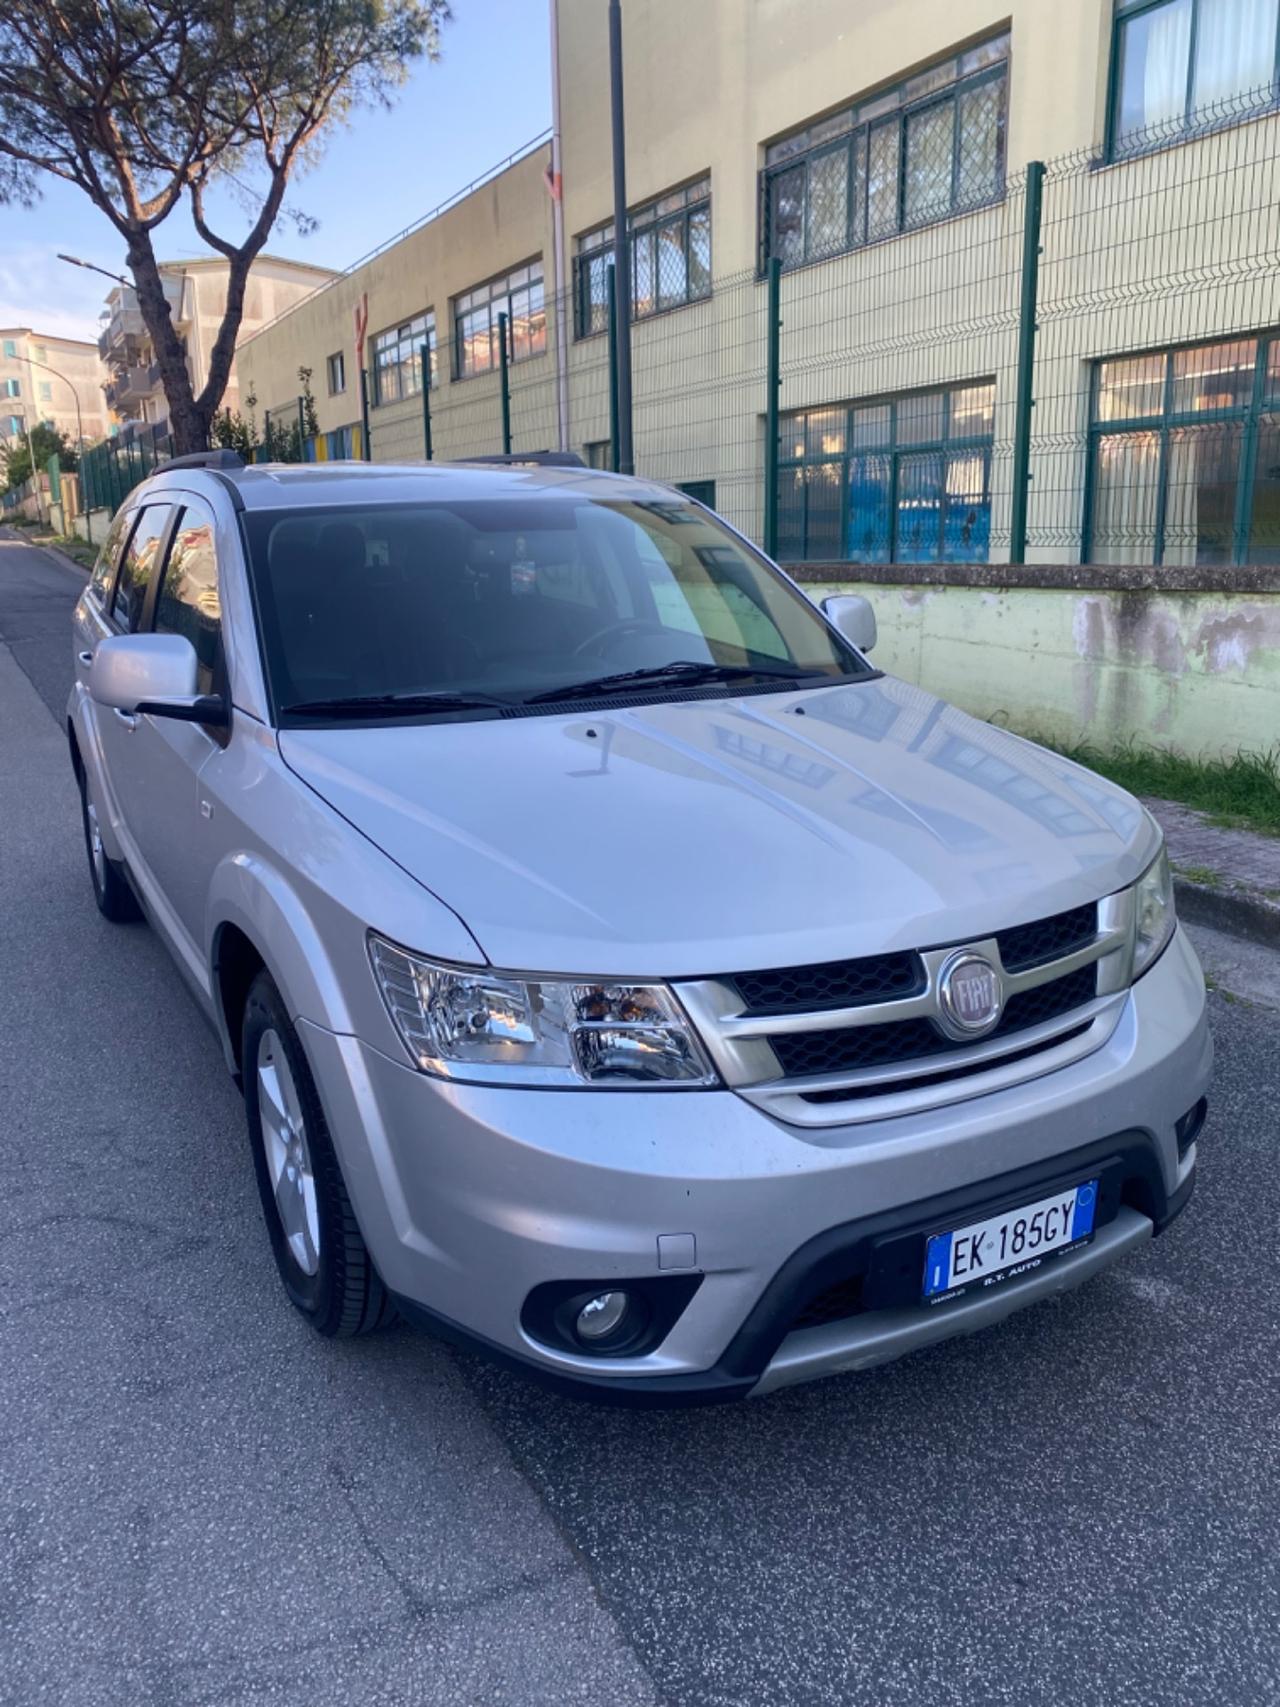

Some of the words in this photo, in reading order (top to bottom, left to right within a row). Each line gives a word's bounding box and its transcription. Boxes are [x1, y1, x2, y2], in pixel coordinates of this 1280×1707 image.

[953, 1231, 986, 1276] EK
[1000, 1200, 1074, 1260] 185GY
[1008, 1259, 1041, 1277] AUTO
